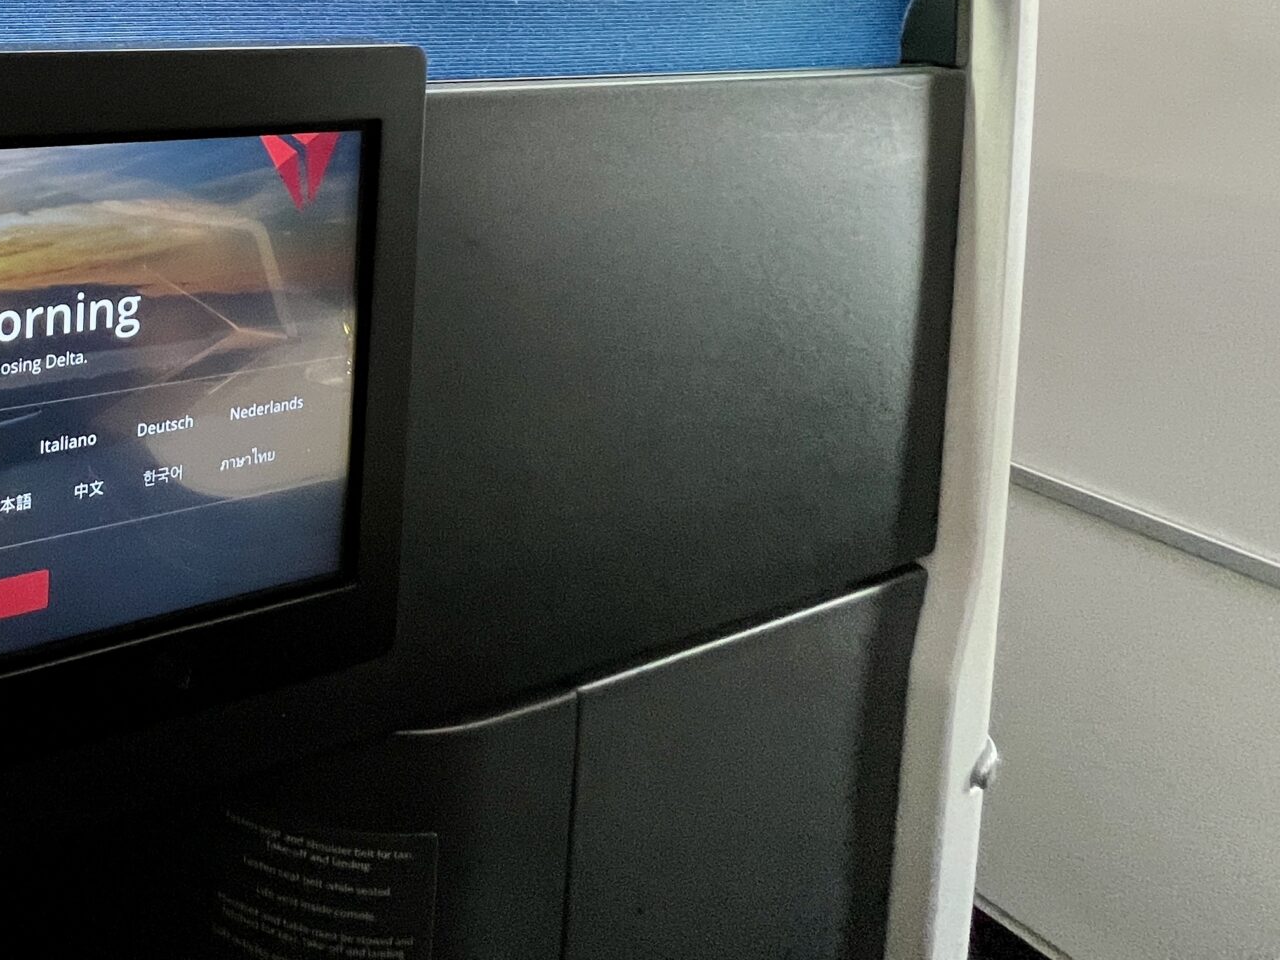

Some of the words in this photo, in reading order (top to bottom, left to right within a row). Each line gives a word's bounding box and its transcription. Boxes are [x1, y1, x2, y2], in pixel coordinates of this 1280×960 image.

[45, 351, 88, 370] Delta.
[230, 396, 304, 421] Nederlands
[137, 415, 194, 437] Deutsch
[40, 433, 97, 454] Italiano
[220, 447, 276, 471] ภาษาไทย
[142, 464, 183, 487] 한국어
[73, 480, 104, 500] 中文
